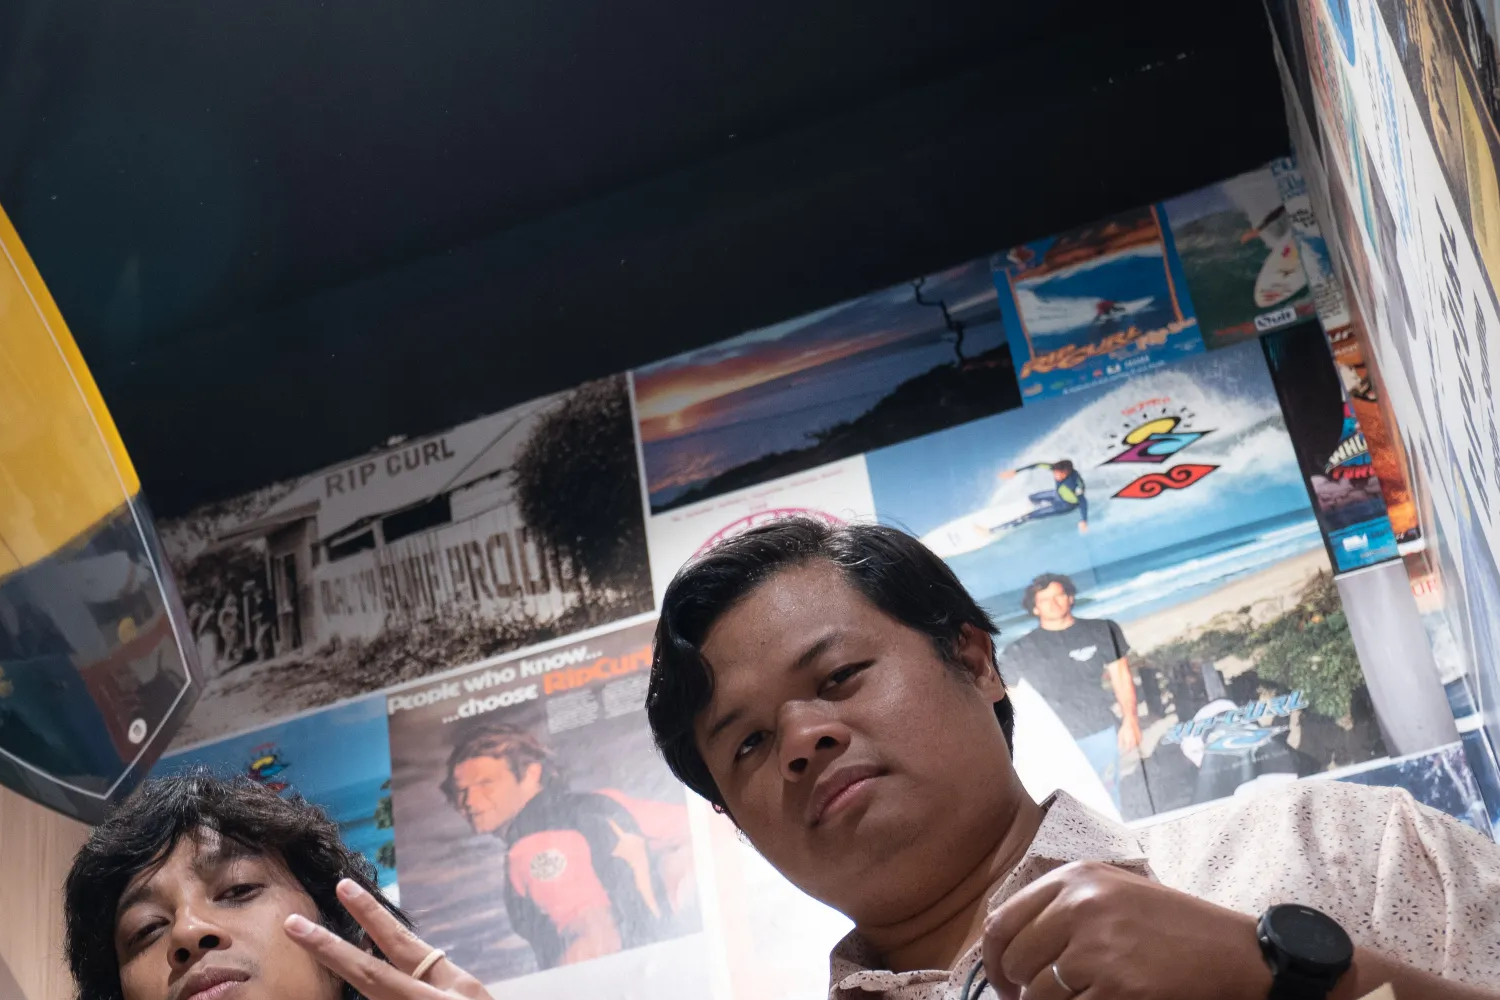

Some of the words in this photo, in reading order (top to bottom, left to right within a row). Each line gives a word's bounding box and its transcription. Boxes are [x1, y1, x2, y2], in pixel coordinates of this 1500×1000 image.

[325, 463, 377, 498] RIP
[386, 437, 456, 476] CURL
[387, 680, 460, 715] People
[463, 667, 516, 693] who
[520, 646, 603, 678] know...
[442, 683, 539, 724] ...choose
